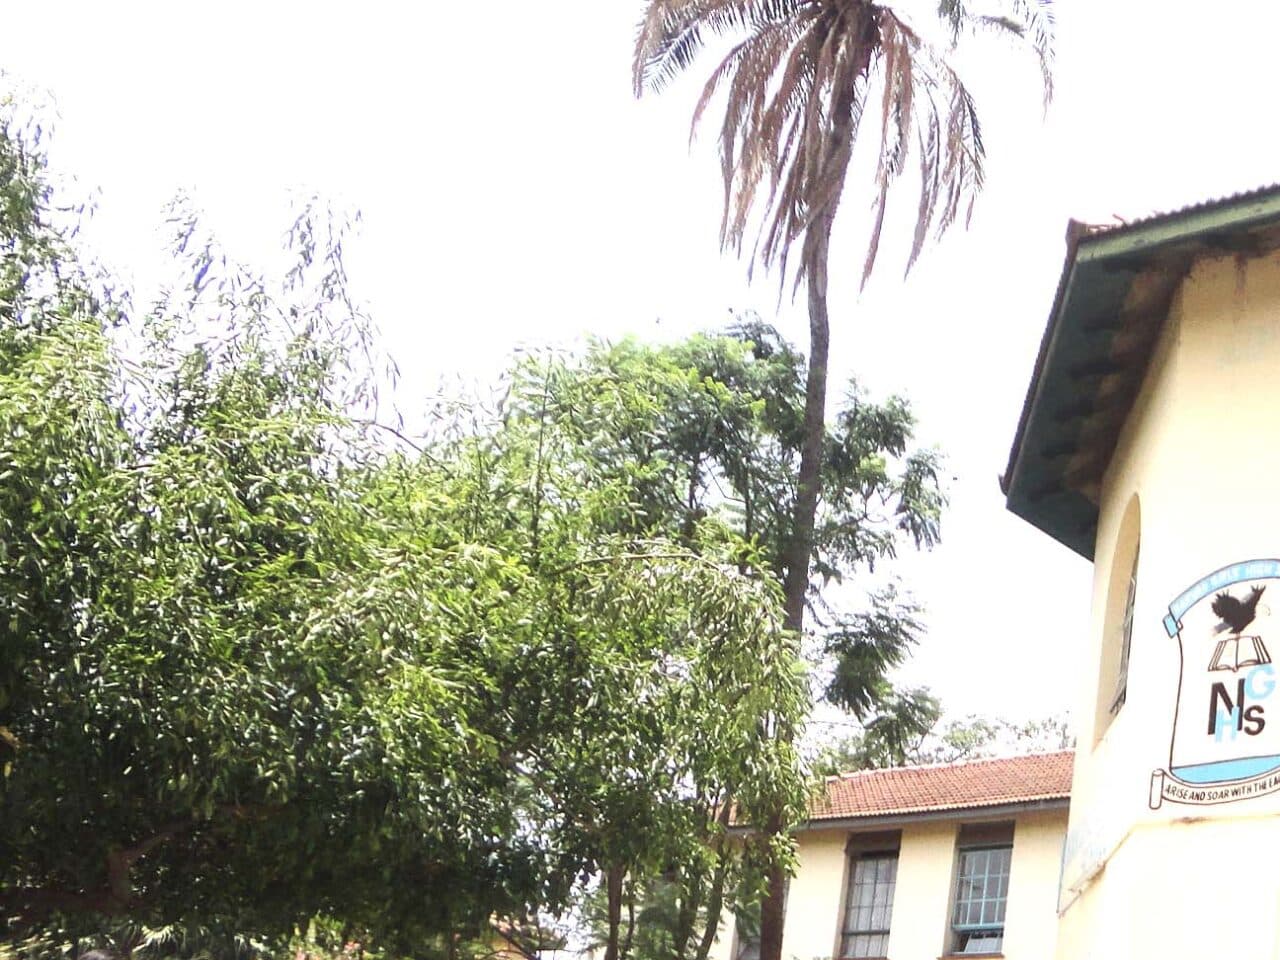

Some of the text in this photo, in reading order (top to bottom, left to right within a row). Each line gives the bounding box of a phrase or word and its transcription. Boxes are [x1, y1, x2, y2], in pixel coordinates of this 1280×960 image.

[1165, 783, 1188, 800] ARISE
[1189, 790, 1206, 801] AND
[1206, 789, 1229, 801] SOAR
[1231, 784, 1252, 797] WITH
[1254, 780, 1267, 792] THE
